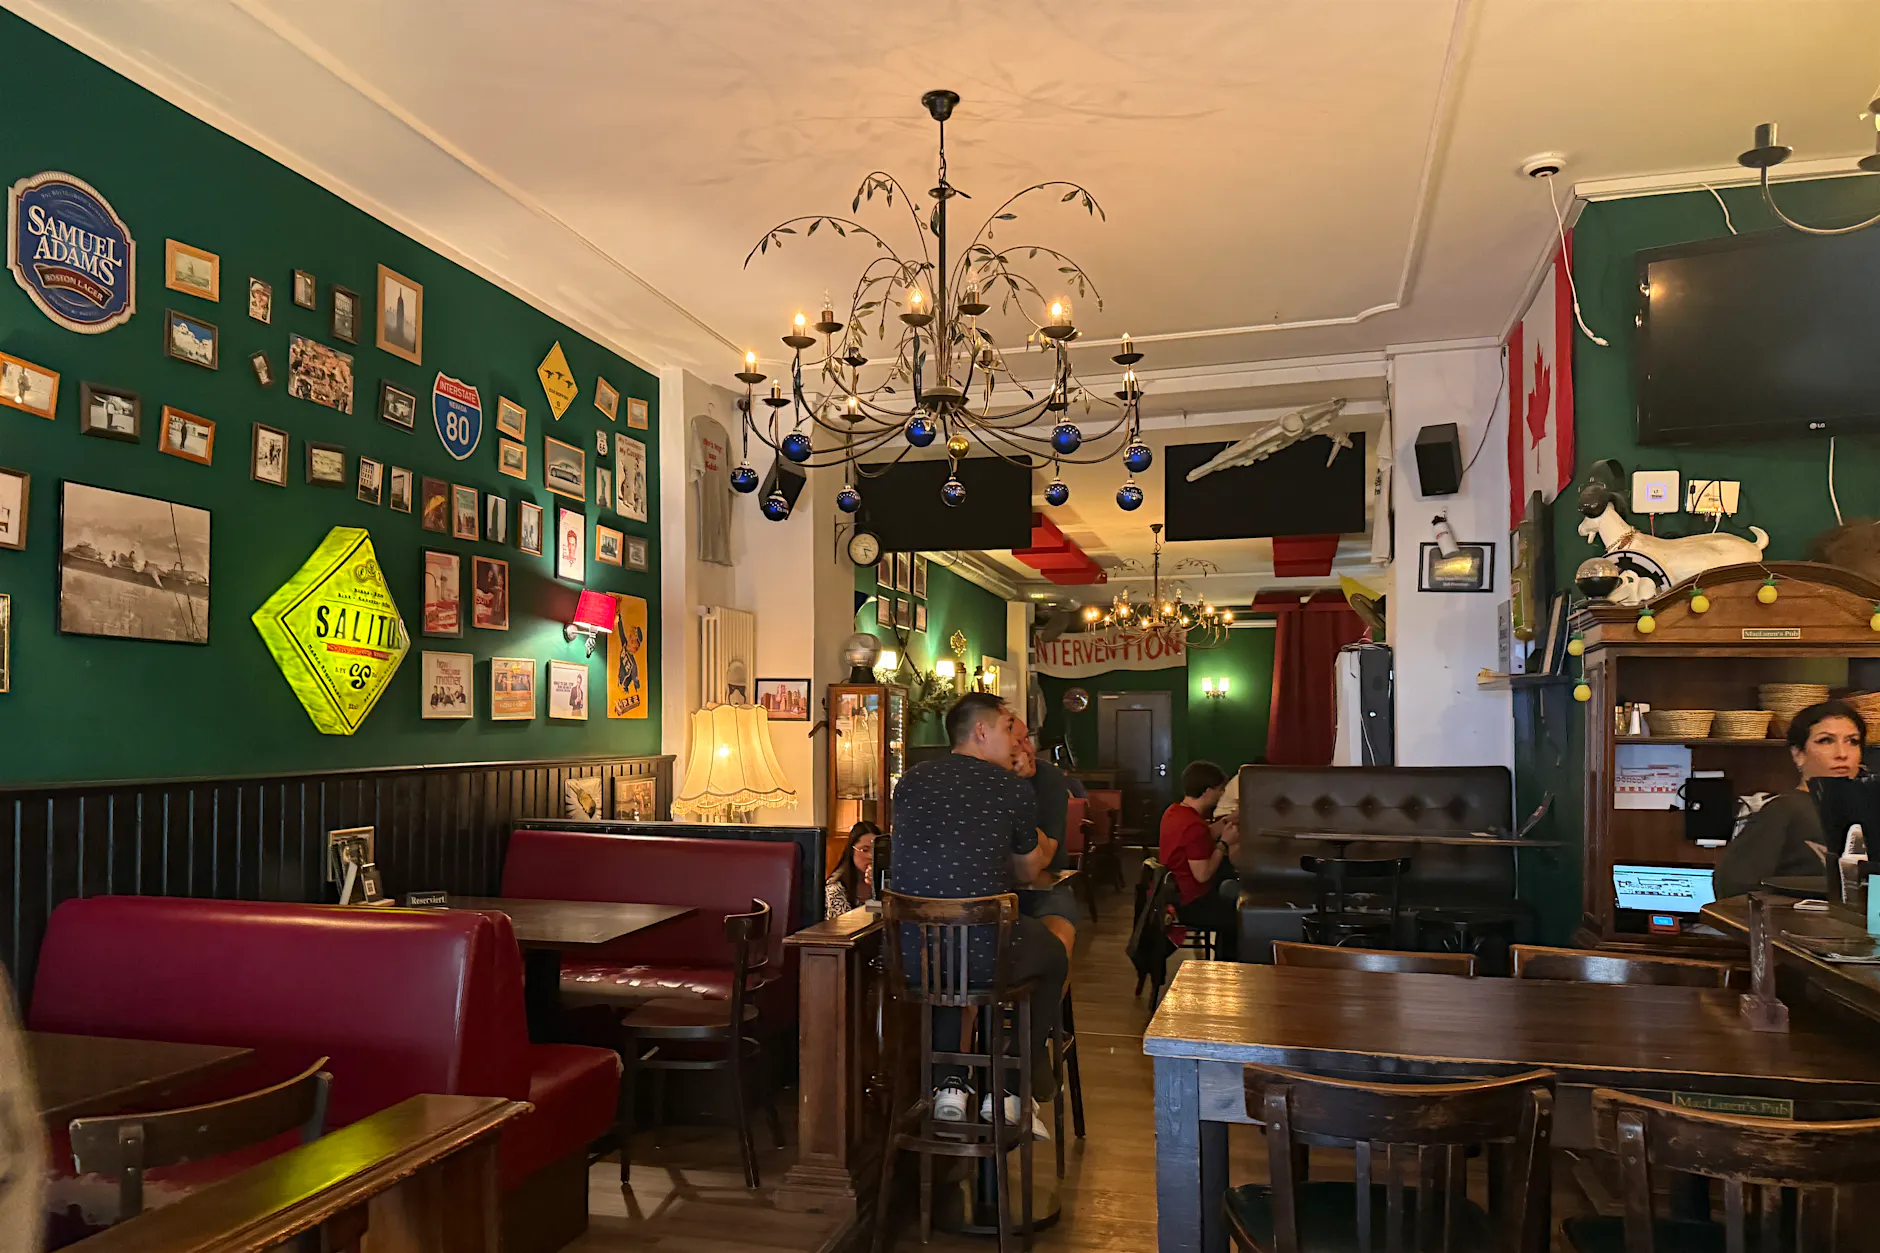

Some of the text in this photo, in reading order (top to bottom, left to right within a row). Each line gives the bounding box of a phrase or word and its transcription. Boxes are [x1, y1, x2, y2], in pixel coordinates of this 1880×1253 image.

[27, 205, 122, 267] SAMUEL
[33, 236, 115, 286] ADAMS
[45, 273, 103, 301] BOSTON LAGER
[439, 380, 477, 404] INTERSTATE
[446, 411, 470, 446] 80
[411, 895, 445, 905] Reserviert
[1761, 1103, 1789, 1115] Pub
